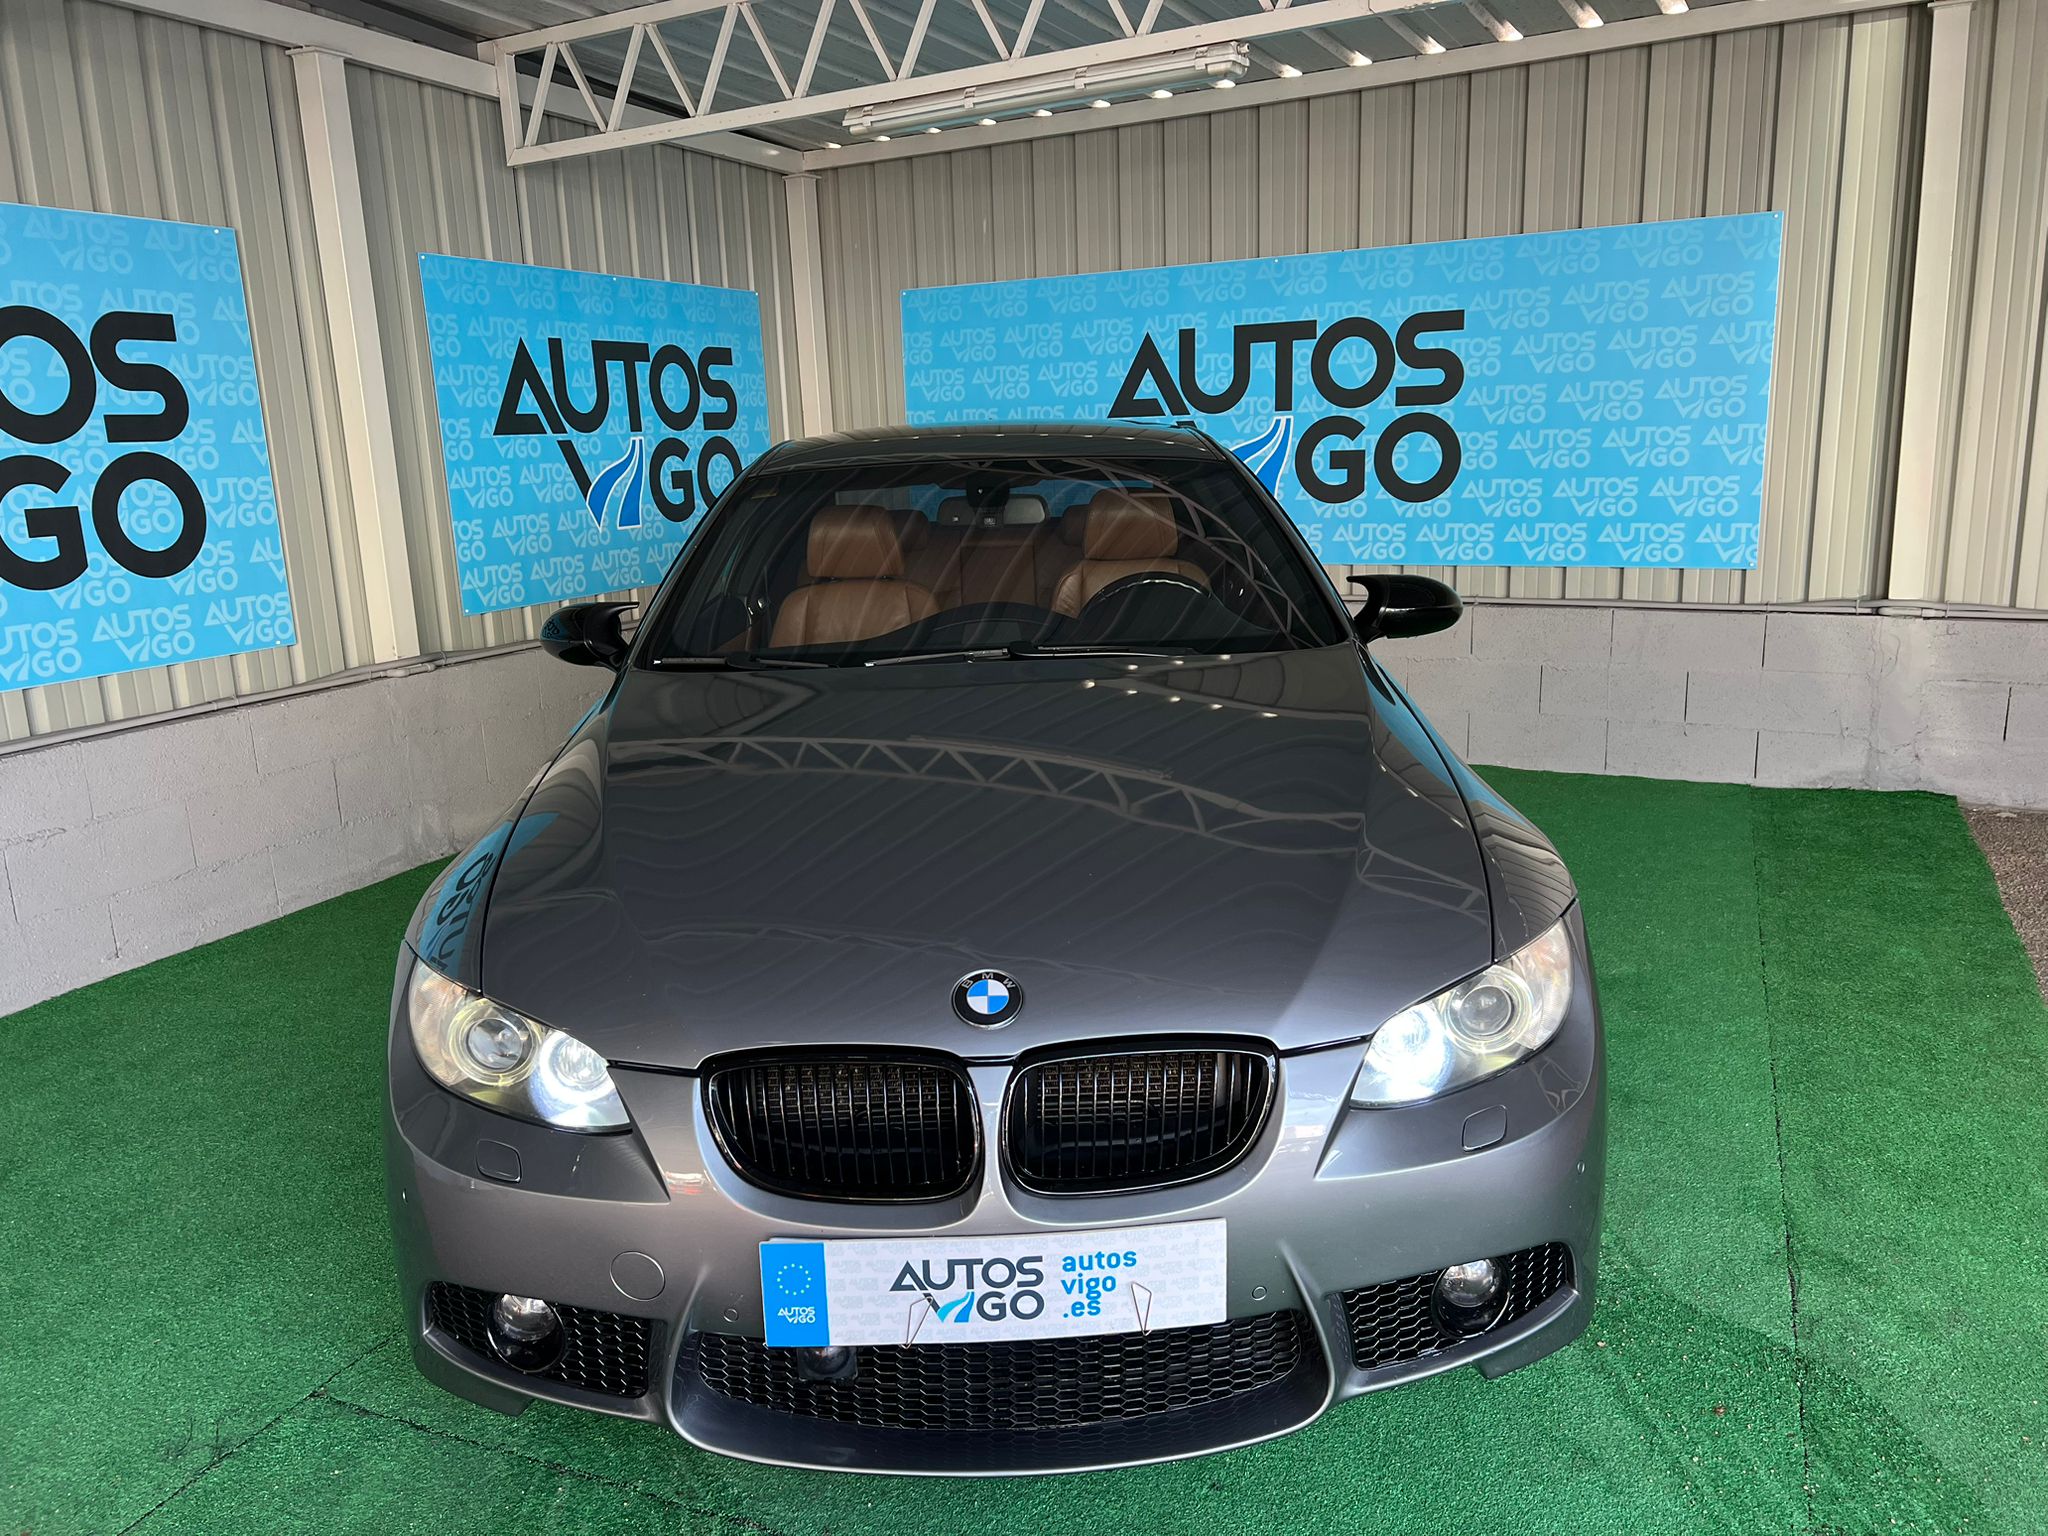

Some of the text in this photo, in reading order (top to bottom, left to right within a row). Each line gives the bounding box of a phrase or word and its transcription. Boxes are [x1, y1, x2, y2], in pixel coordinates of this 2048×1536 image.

[22, 212, 129, 246] AUTOS
[1615, 223, 1704, 249] AUTOS
[1425, 241, 1504, 265] AUTOS
[1517, 232, 1601, 257] AUTOS
[48, 240, 133, 274] VIGO
[162, 247, 240, 283] VIGO
[1340, 249, 1413, 272] AUTOS
[1535, 253, 1600, 276] VIGO
[1633, 244, 1702, 269] VIGO
[424, 259, 488, 283] AUTOS
[496, 266, 554, 289] AUTOS
[1180, 264, 1245, 285] AUTOS
[1258, 257, 1327, 279] AUTOS
[1442, 261, 1503, 283] VIGO
[563, 274, 612, 295] AUTOS
[1037, 277, 1096, 297] AUTOS
[1106, 271, 1169, 291] AUTOS
[1273, 275, 1327, 296] VIGO
[1357, 268, 1413, 290] VIGO
[1663, 272, 1755, 297] AUTOS
[620, 280, 665, 300] AUTOS
[673, 286, 713, 305] AUTOS
[722, 291, 758, 309] AUTOS
[908, 289, 961, 307] AUTOS
[971, 283, 1027, 302] AUTOS
[1121, 288, 1169, 308] VIGO
[1195, 282, 1245, 302] VIGO
[1472, 287, 1551, 310] AUTOS
[1565, 280, 1650, 303] AUTOS
[921, 305, 962, 323] VIGO
[984, 300, 1028, 318] VIGO
[1051, 294, 1096, 313] VIGO
[1583, 301, 1648, 324] VIGO
[1682, 294, 1754, 318] VIGO
[467, 315, 528, 338] AUTOS
[1072, 318, 1132, 337] AUTOS
[1489, 308, 1550, 330] VIGO
[942, 328, 995, 345] AUTOS
[1005, 323, 1062, 341] AUTOS
[1514, 331, 1596, 354] AUTOS
[1610, 325, 1697, 349] AUTOS
[955, 345, 996, 363] VIGO
[1019, 341, 1063, 359] VIGO
[1087, 336, 1133, 355] VIGO
[1107, 309, 1465, 418] AUTOS
[1531, 353, 1595, 374] VIGO
[1628, 347, 1696, 369] VIGO
[438, 364, 500, 386] AUTOS
[912, 369, 964, 386] AUTOS
[974, 365, 1030, 383] AUTOS
[1039, 361, 1098, 379] AUTOS
[186, 376, 259, 407] VIGO
[493, 336, 738, 435] AUTOS
[925, 386, 965, 402] VIGO
[987, 383, 1030, 399] VIGO
[1053, 379, 1098, 396] VIGO
[1469, 384, 1547, 405] AUTOS
[1560, 380, 1644, 402] AUTOS
[1657, 375, 1748, 398] AUTOS
[453, 387, 502, 407] VIGO
[1486, 405, 1546, 425] VIGO
[1578, 401, 1643, 422] VIGO
[1676, 397, 1746, 419] VIGO
[1510, 429, 1592, 449] AUTOS
[1605, 426, 1691, 446] AUTOS
[496, 439, 541, 458] VIGO
[1623, 447, 1690, 467] VIGO
[1528, 450, 1591, 469] VIGO
[449, 466, 512, 488] AUTOS
[1554, 477, 1639, 496] AUTOS
[1650, 476, 1741, 495] AUTOS
[466, 487, 514, 508] VIGO
[535, 484, 577, 503] VIGO
[1464, 479, 1543, 497] AUTOS
[206, 502, 277, 529] VIGO
[1391, 499, 1451, 518] VIGO
[1481, 499, 1542, 517] VIGO
[1572, 498, 1638, 516] VIGO
[1668, 498, 1739, 516] VIGO
[492, 514, 550, 537] AUTOS
[1335, 525, 1407, 541] AUTOS
[1417, 525, 1494, 541] AUTOS
[1505, 525, 1587, 542] AUTOS
[1598, 524, 1685, 542] AUTOS
[508, 533, 552, 555] VIGO
[572, 528, 610, 547] VIGO
[592, 547, 640, 570] AUTOS
[1351, 543, 1407, 559] VIGO
[1433, 543, 1494, 560] VIGO
[1522, 544, 1586, 561] VIGO
[1616, 544, 1684, 562] VIGO
[462, 564, 523, 589] AUTOS
[531, 556, 585, 579] AUTOS
[605, 567, 642, 586] VIGO
[167, 567, 238, 596] VIGO
[546, 574, 587, 597] VIGO
[479, 583, 525, 606] VIGO
[204, 592, 291, 626] AUTOS
[92, 604, 191, 642] AUTOS
[225, 617, 294, 646] VIGO
[116, 631, 195, 662] VIGO
[961, 973, 1016, 989] BMW
[1062, 1251, 1137, 1273] autos
[889, 1256, 1045, 1291] AUTOS
[1061, 1273, 1117, 1301] vigo
[777, 1306, 816, 1316] AUTOS
[922, 1290, 1046, 1323] VIGO
[1063, 1300, 1101, 1318] .es
[784, 1315, 816, 1324] VIGO
